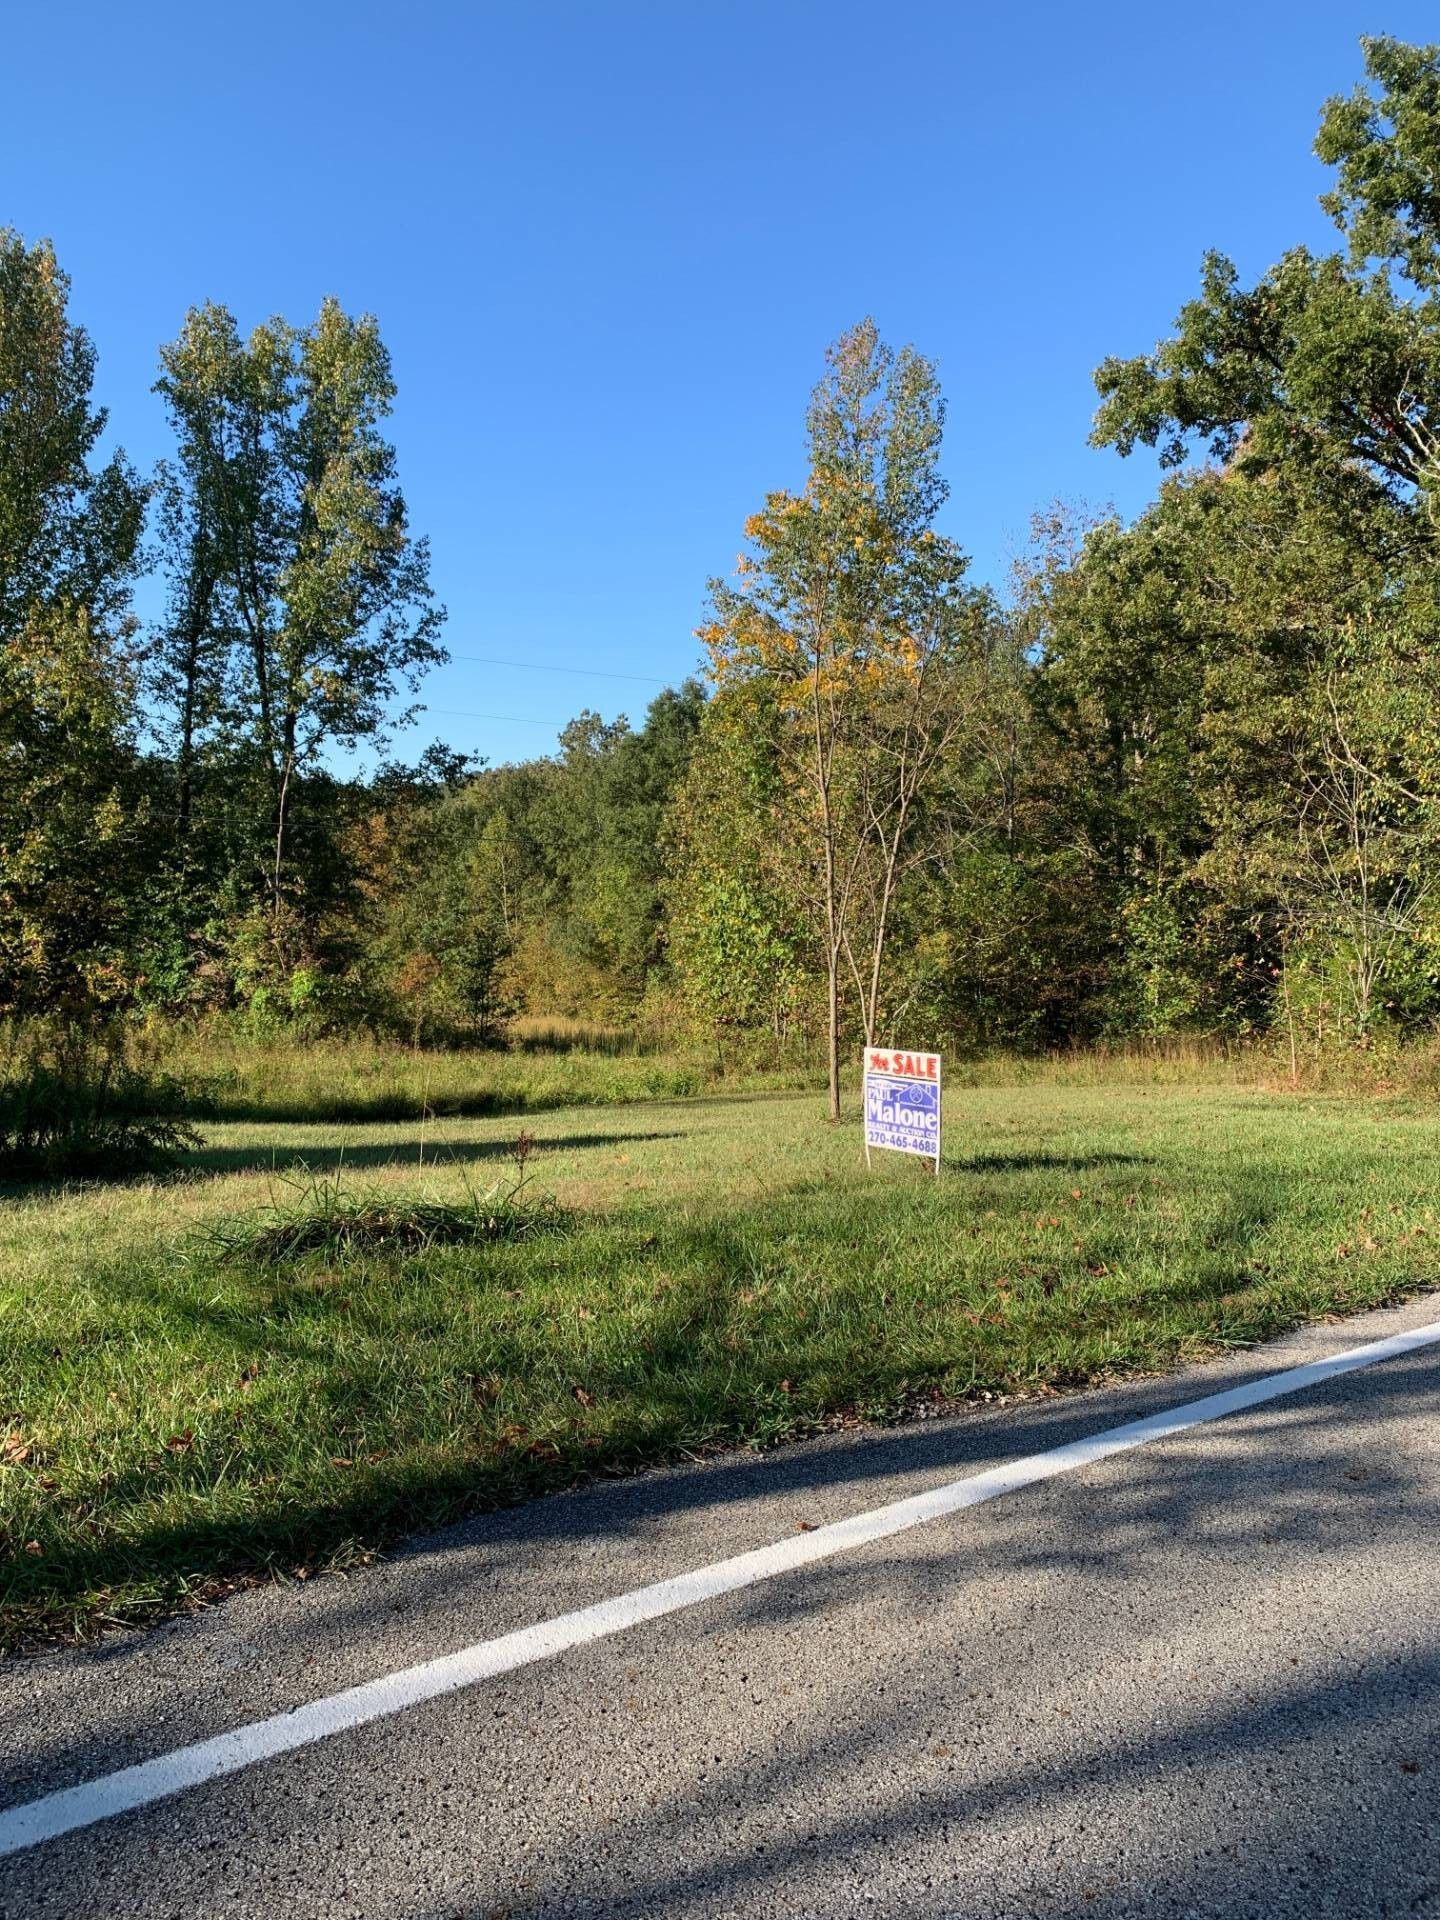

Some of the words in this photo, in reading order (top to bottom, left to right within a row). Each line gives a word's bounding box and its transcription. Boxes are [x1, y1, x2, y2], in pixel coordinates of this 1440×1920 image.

[893, 1053, 937, 1078] SALE
[868, 1087, 894, 1101] PAUL
[868, 1099, 938, 1131] Malone
[868, 1131, 937, 1154] 270-465-4688
